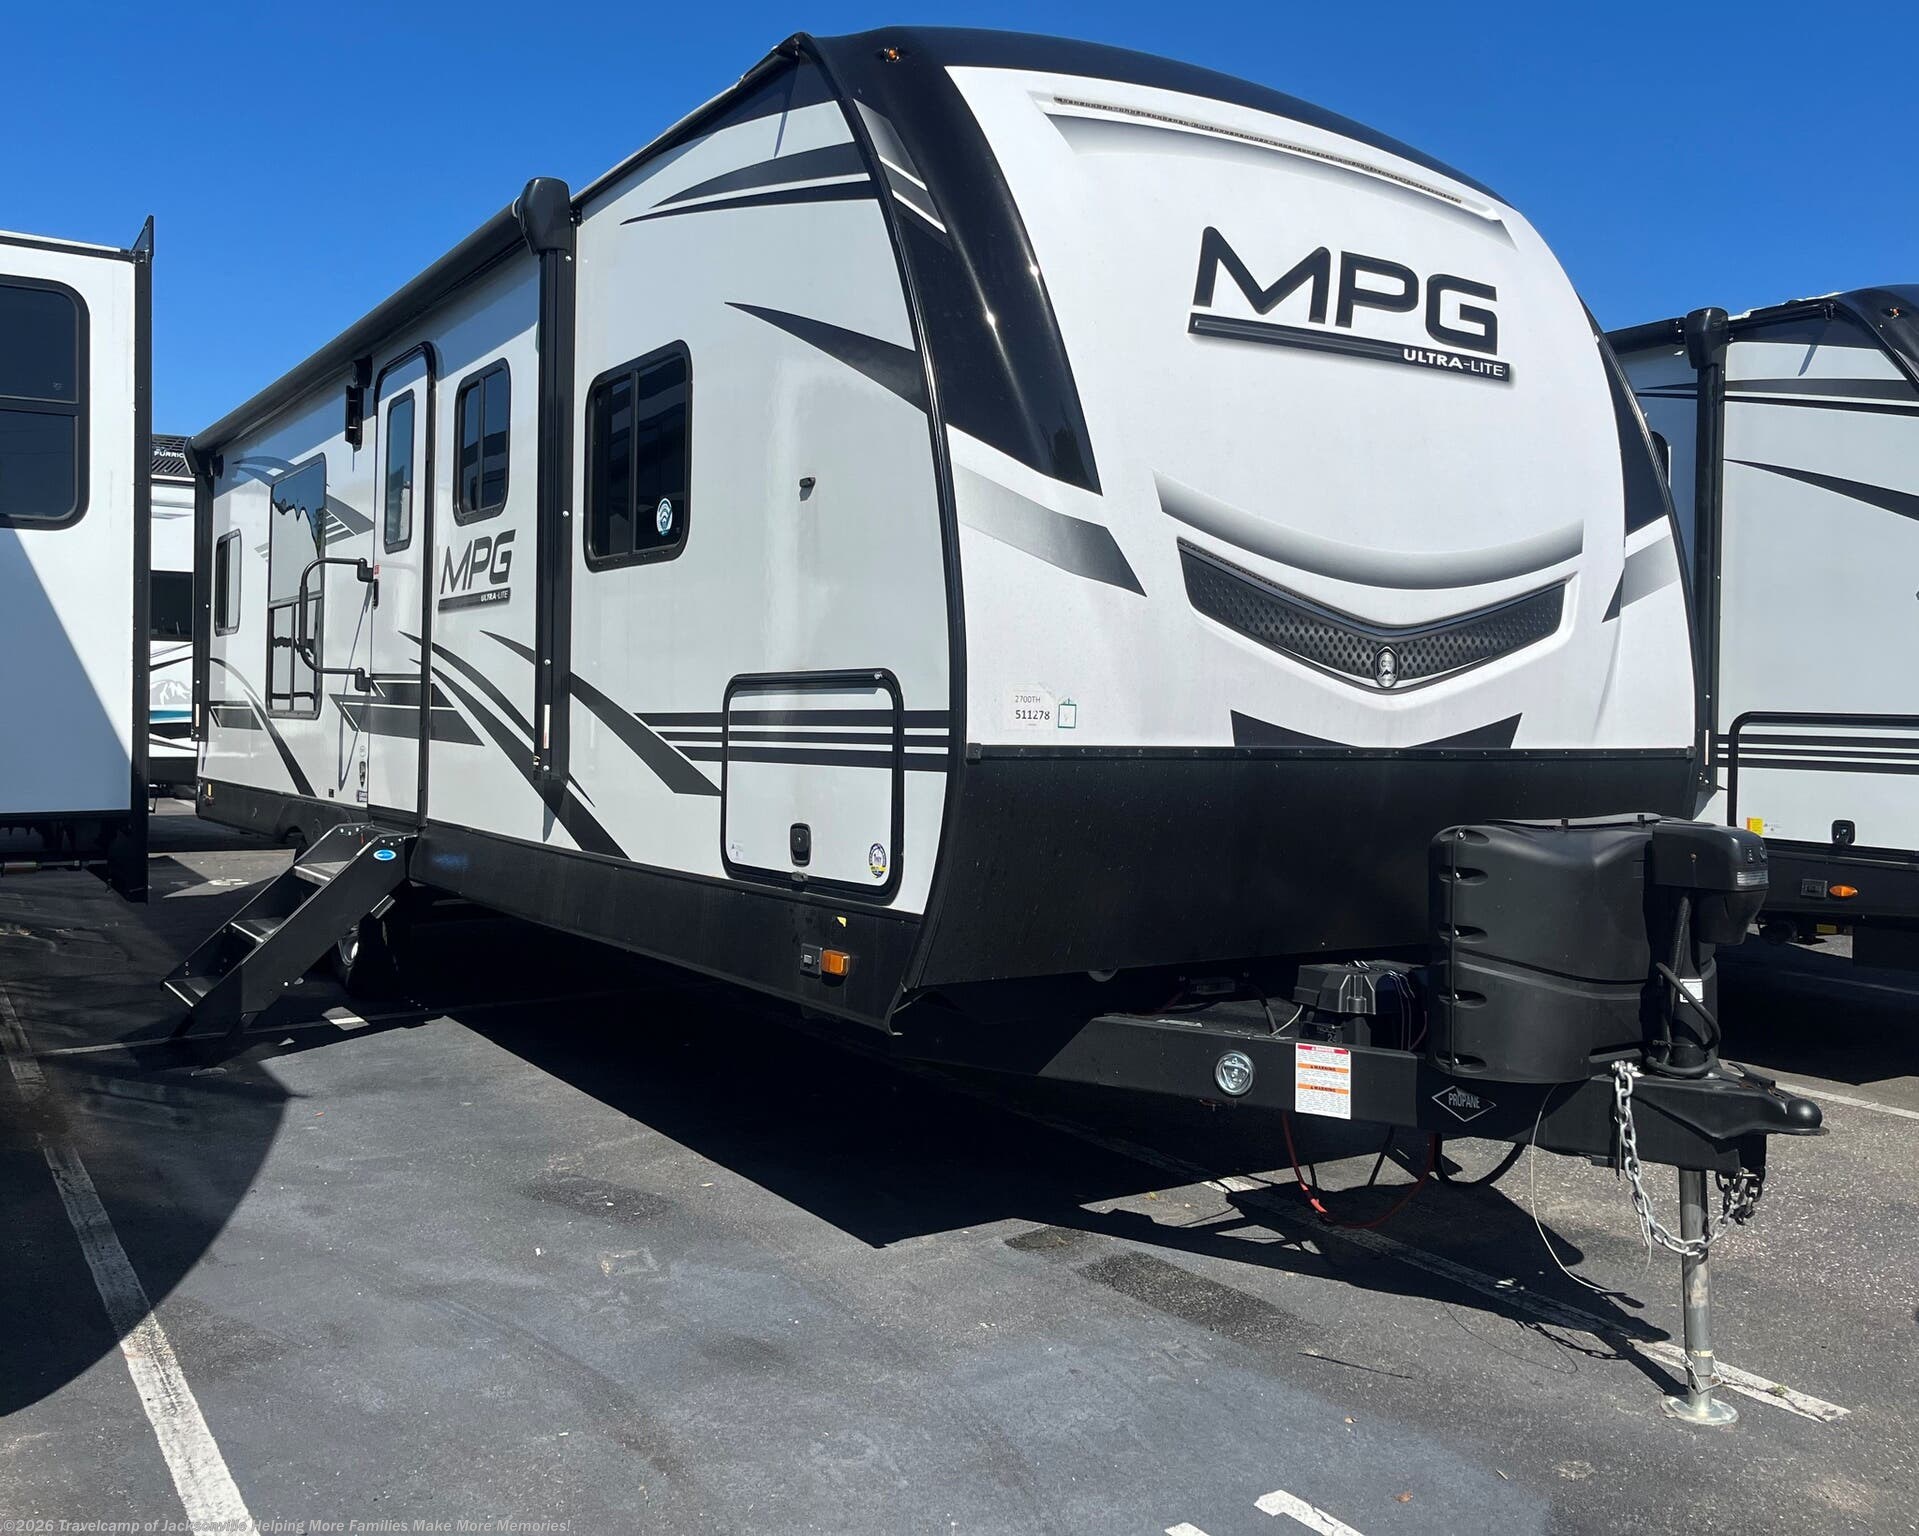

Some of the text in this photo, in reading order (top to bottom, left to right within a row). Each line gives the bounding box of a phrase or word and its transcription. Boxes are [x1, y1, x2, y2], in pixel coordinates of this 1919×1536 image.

[1192, 226, 1498, 356] MPG
[1403, 348, 1504, 376] ULTRA-LITE
[440, 528, 516, 595] MPG
[1015, 695, 1041, 704] 2700TH
[1015, 709, 1051, 720] 511278
[1448, 1092, 1481, 1109] PROPANE
